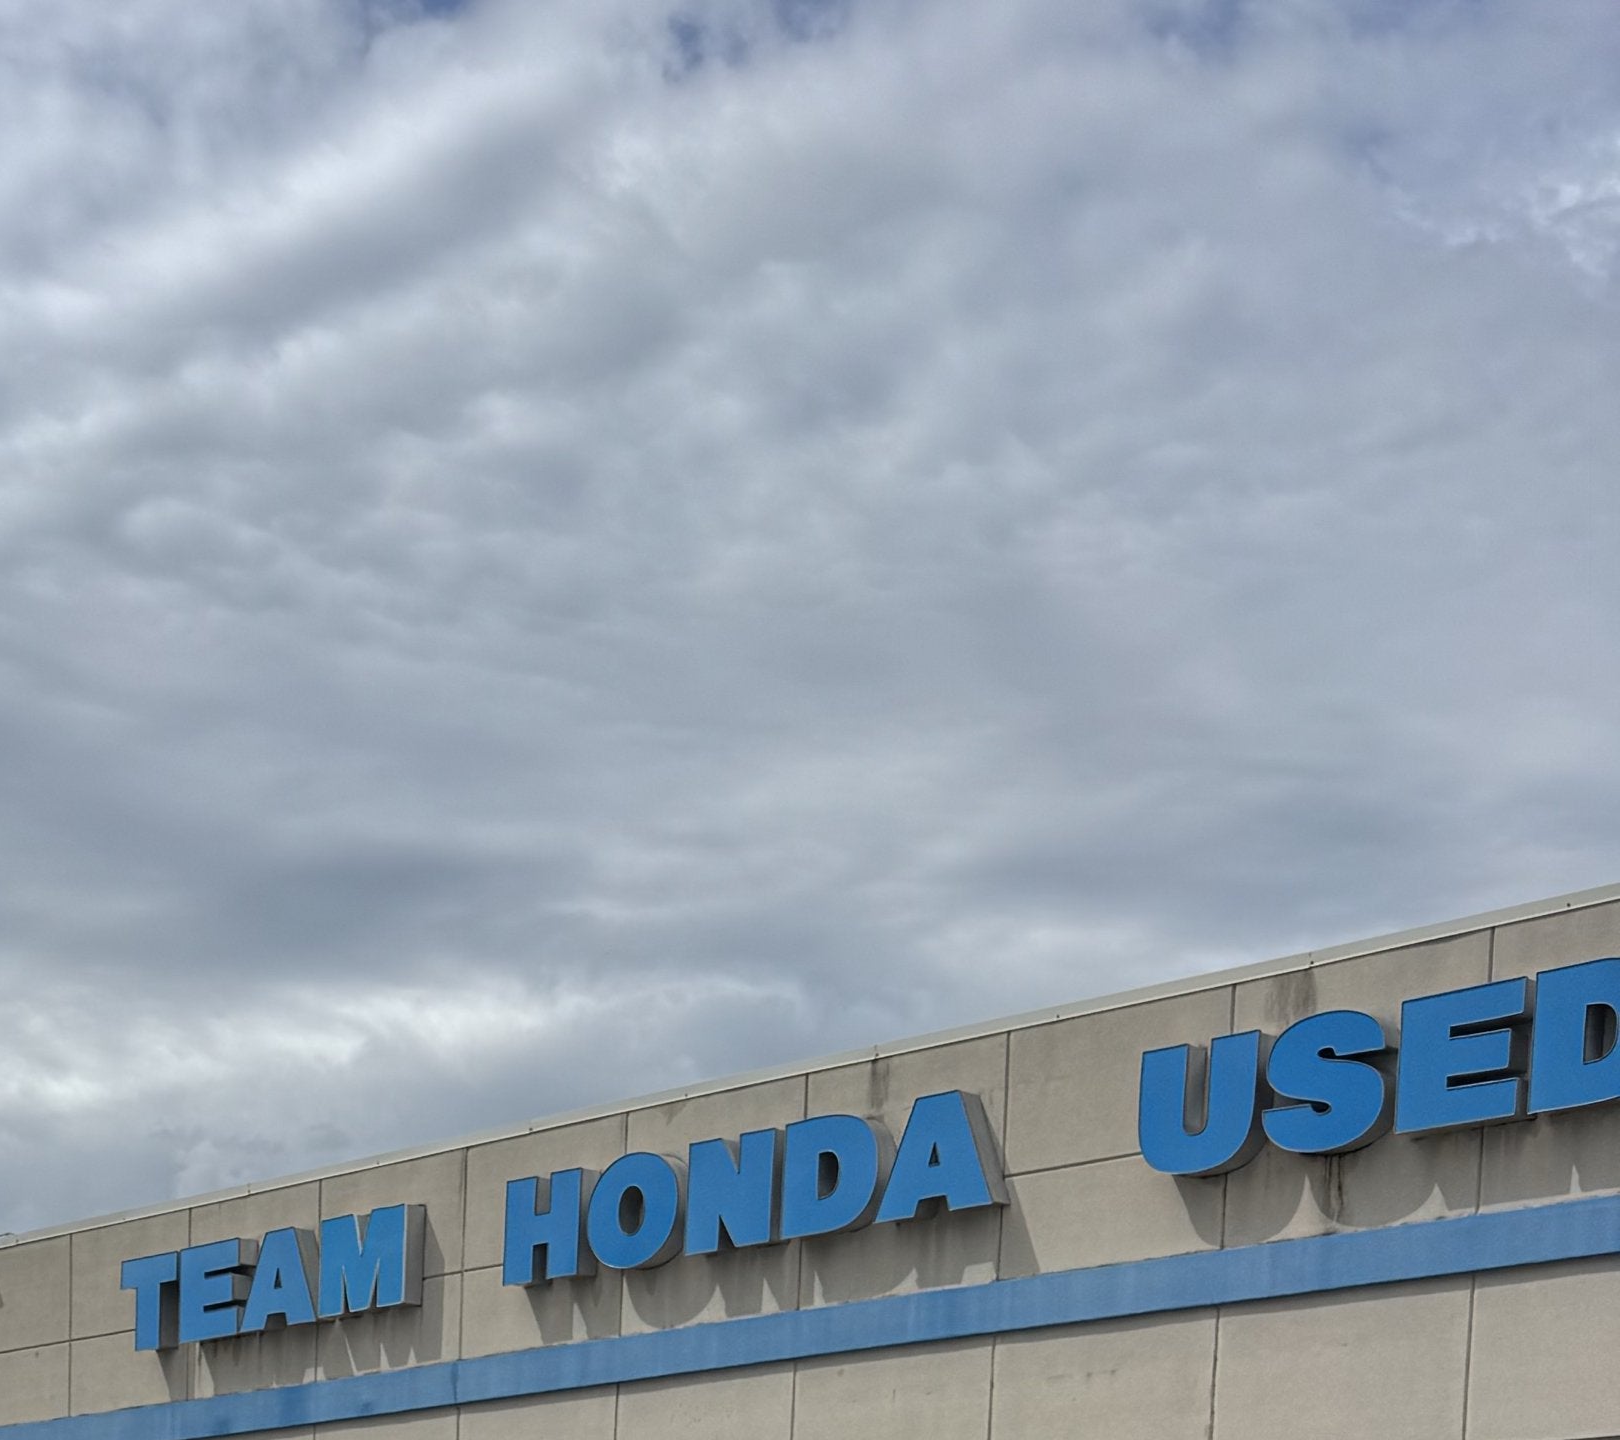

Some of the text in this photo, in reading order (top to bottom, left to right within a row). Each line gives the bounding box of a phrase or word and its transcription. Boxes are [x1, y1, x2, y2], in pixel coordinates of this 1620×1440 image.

[120, 957, 1620, 1351] TEAM HONDA USED
